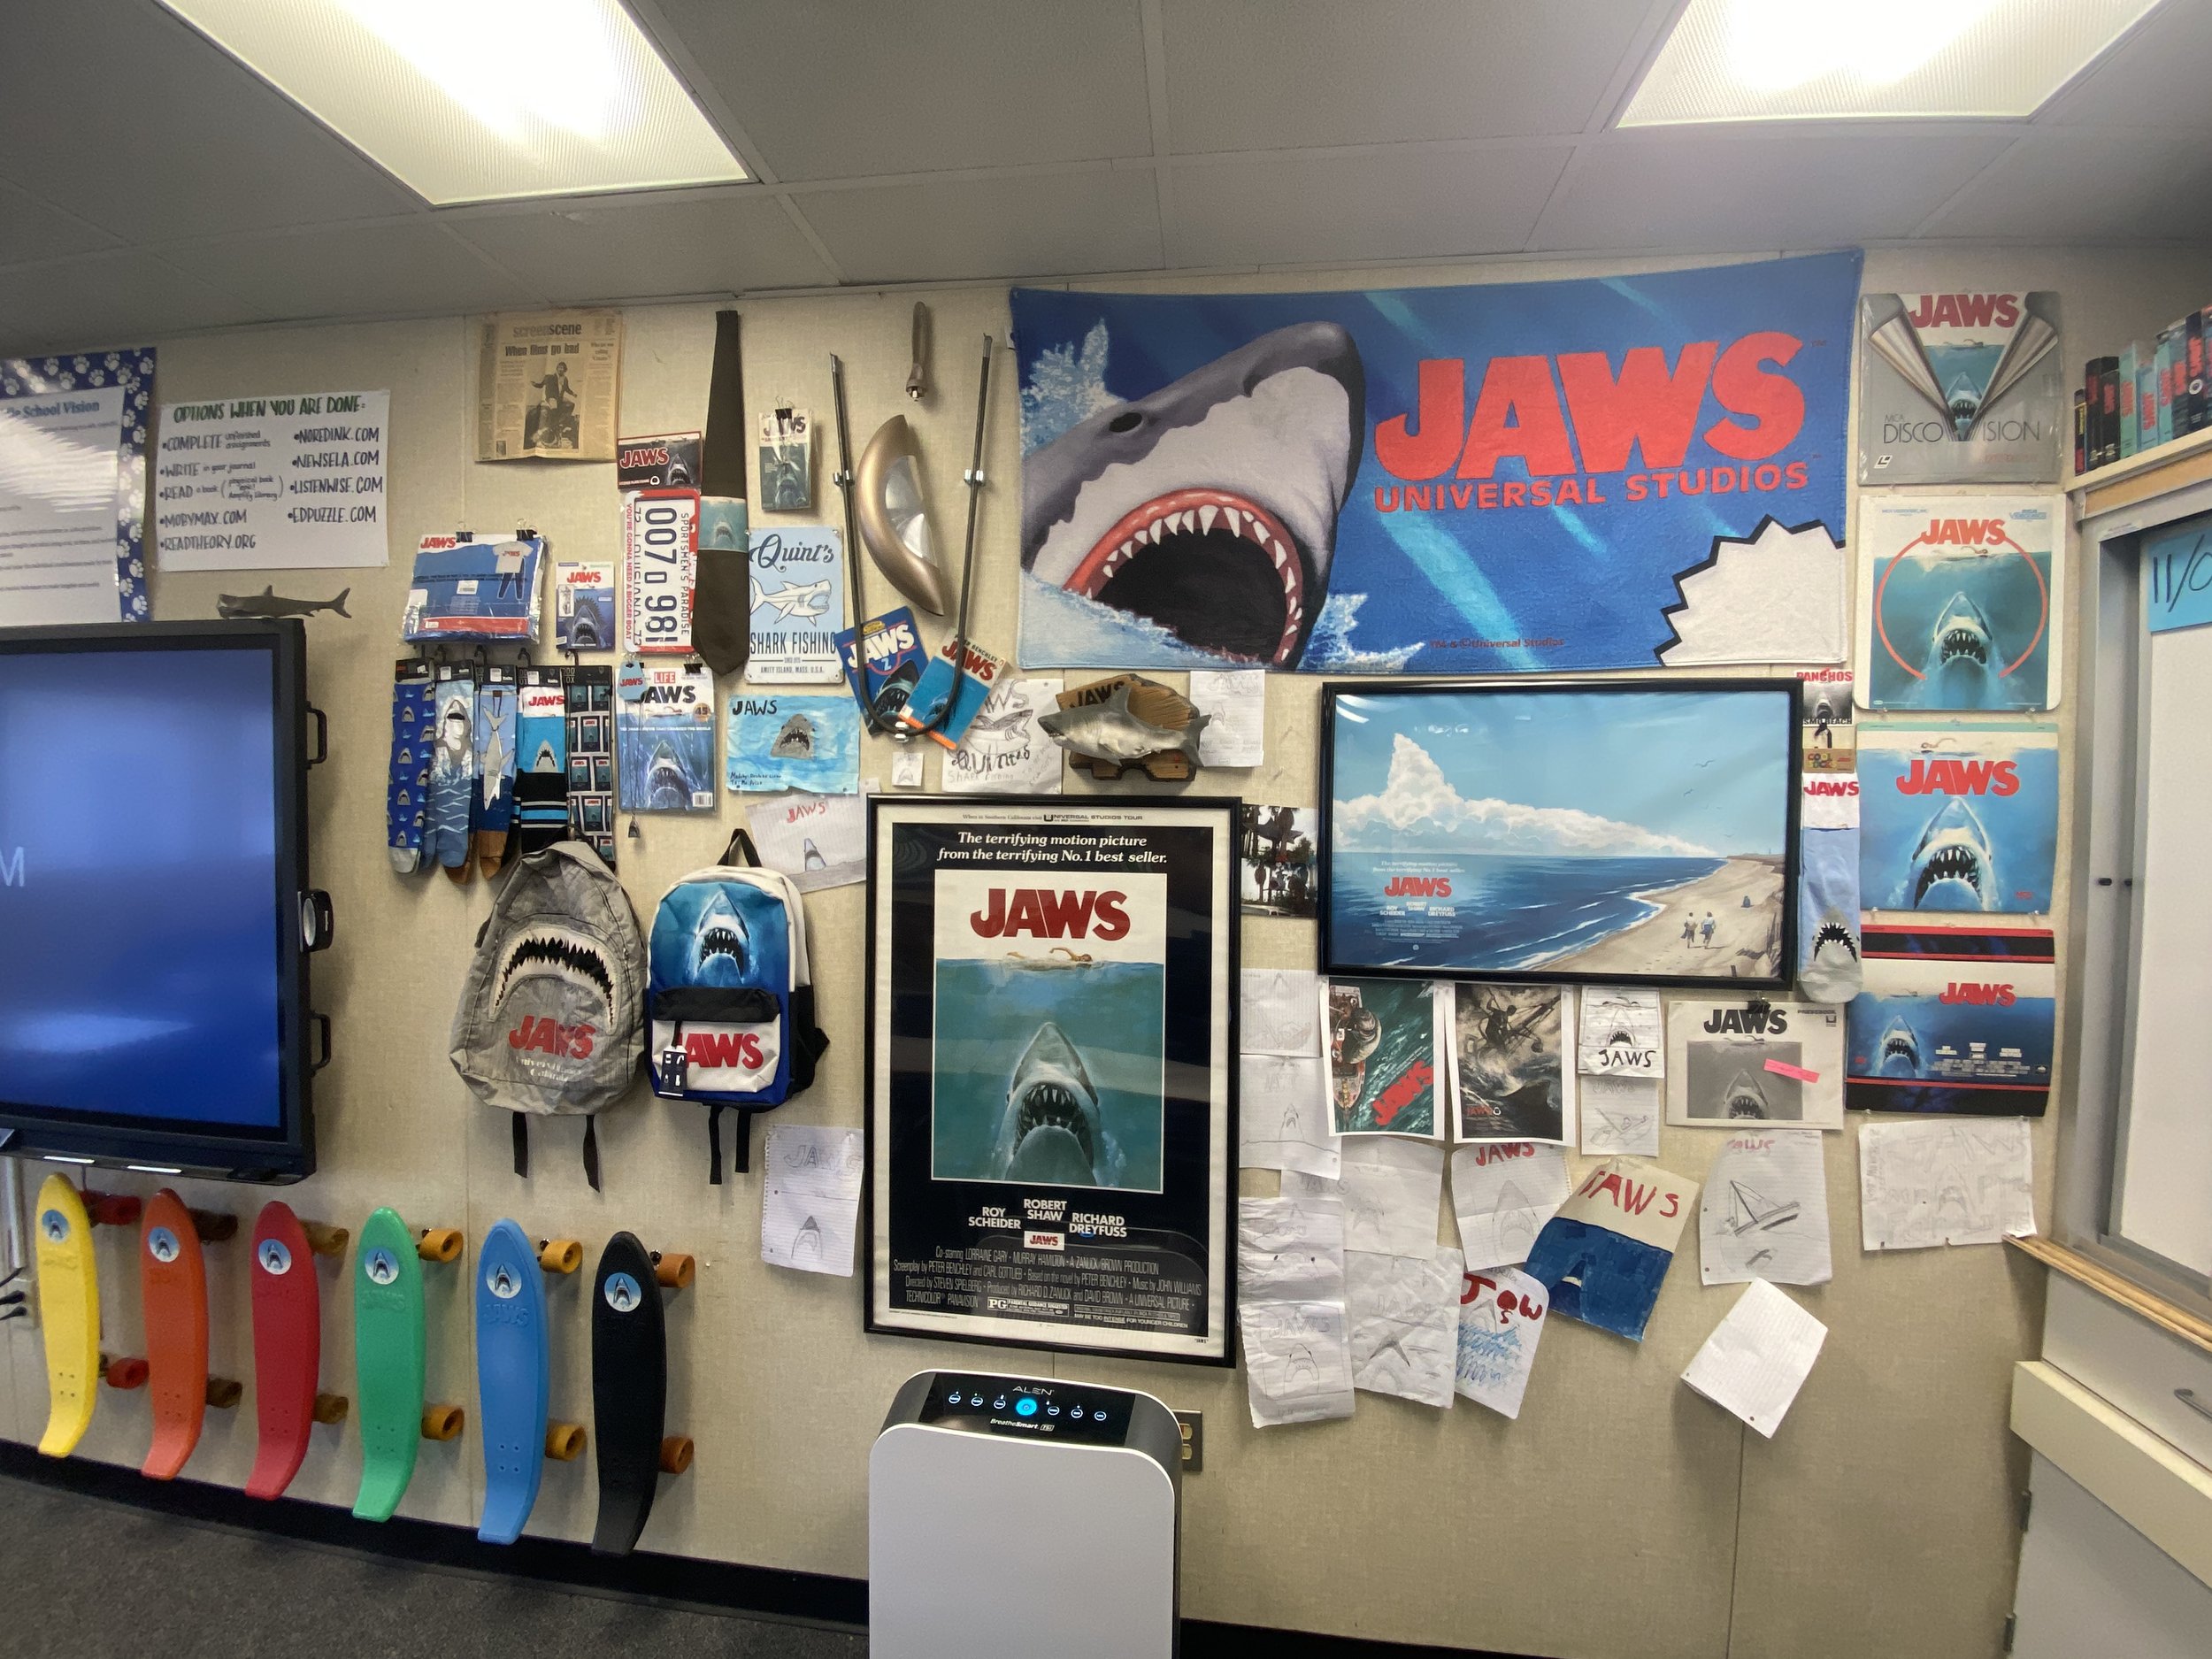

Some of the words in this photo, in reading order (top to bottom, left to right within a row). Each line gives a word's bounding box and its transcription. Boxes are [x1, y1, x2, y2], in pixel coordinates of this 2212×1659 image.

[1909, 294, 2020, 328] JAWS
[23, 403, 60, 419] School
[64, 401, 99, 414] Vision
[173, 403, 225, 423] OPTIONS
[230, 401, 265, 419] WHEN
[270, 399, 295, 416] YOU
[299, 397, 322, 415] ARE
[1374, 331, 1806, 480] JAWS
[166, 434, 223, 451] COMPLETE
[620, 447, 669, 469] JAWS
[165, 462, 201, 478] WRITE
[227, 462, 256, 474] journal
[164, 485, 193, 501] READ
[1373, 478, 1606, 514] UNIVERSAL
[1625, 461, 1809, 503] STUDIOS
[1922, 518, 2006, 545] JAWS
[420, 537, 456, 549] JAWS
[680, 512, 689, 581] SPORTSMEN'S
[749, 534, 834, 572] Quint's
[567, 572, 601, 583] JAWS
[680, 587, 689, 634] PARADISE
[750, 632, 787, 654] SHARK
[792, 632, 836, 654] FISHING
[1524, 638, 1564, 647] Studios
[972, 644, 998, 662] BENCHLEY
[881, 658, 891, 671] 2
[619, 678, 643, 687] JAWS
[655, 672, 675, 683] LIFE
[528, 695, 565, 706] JAWS
[634, 685, 696, 703] AWS
[733, 700, 778, 716] JAWS
[1895, 759, 2020, 796] JAWS
[1803, 781, 1859, 796] JAWS
[787, 802, 826, 824] JAWS
[958, 832, 982, 844] The
[986, 833, 1048, 847] terrifying
[1050, 835, 1096, 846] motion
[1099, 835, 1147, 848] picture
[937, 848, 970, 862] from
[972, 849, 994, 860] the
[996, 849, 1058, 863] terrifying
[1095, 851, 1124, 863] best
[1128, 852, 1168, 864] seller.
[1384, 877, 1452, 897] JAWS
[971, 888, 1131, 941] JAWS
[1939, 982, 2017, 1007] JAWS
[1703, 1009, 1787, 1035] JAWS
[678, 1033, 764, 1070] AWS
[1599, 1049, 1656, 1067] JAWS
[1372, 1059, 1433, 1126] JAWS
[1476, 1142, 1535, 1166] JAWS
[1579, 1171, 1678, 1217] JAWS
[982, 1207, 1006, 1217] ROY
[1024, 1199, 1067, 1211] ROBERT
[968, 1217, 1021, 1230] SCHEIDER
[1027, 1210, 1064, 1221] SHAW
[1071, 1212, 1125, 1226] RICHARD
[1069, 1223, 1127, 1238] DREYFUSS
[1029, 1234, 1059, 1247] JAWS
[993, 1249, 1009, 1263] GARY
[1013, 1251, 1036, 1265] MURRAY
[1038, 1253, 1064, 1267] HAMILTON
[1124, 1260, 1159, 1275] PRODUCTION
[894, 1259, 919, 1272] Screenplay
[929, 1261, 944, 1272] PETER
[946, 1262, 972, 1275] BENCHLEY
[984, 1265, 996, 1277] CARL
[998, 1266, 1022, 1280] GOTTLIEB
[1028, 1269, 1043, 1281] Based
[1081, 1273, 1098, 1286] PETER
[1099, 1274, 1127, 1288] BENCHLEY
[1133, 1277, 1148, 1290] Music
[1156, 1279, 1172, 1293] JOHN
[1174, 1281, 1202, 1295] WILLIAMS
[905, 1276, 926, 1287] Directed
[933, 1277, 953, 1289] STEVEN
[955, 1279, 982, 1293] SPIELBERG
[987, 1281, 1010, 1294] Produced
[1018, 1284, 1042, 1297] RICHARD
[1049, 1286, 1072, 1300] ZANUCK
[1084, 1289, 1102, 1302] DAVID
[1102, 1291, 1124, 1304] BROWN
[1134, 1294, 1166, 1309] UNIVERSAL
[1166, 1296, 1190, 1311] PICTURE
[988, 1299, 1007, 1310] PG
